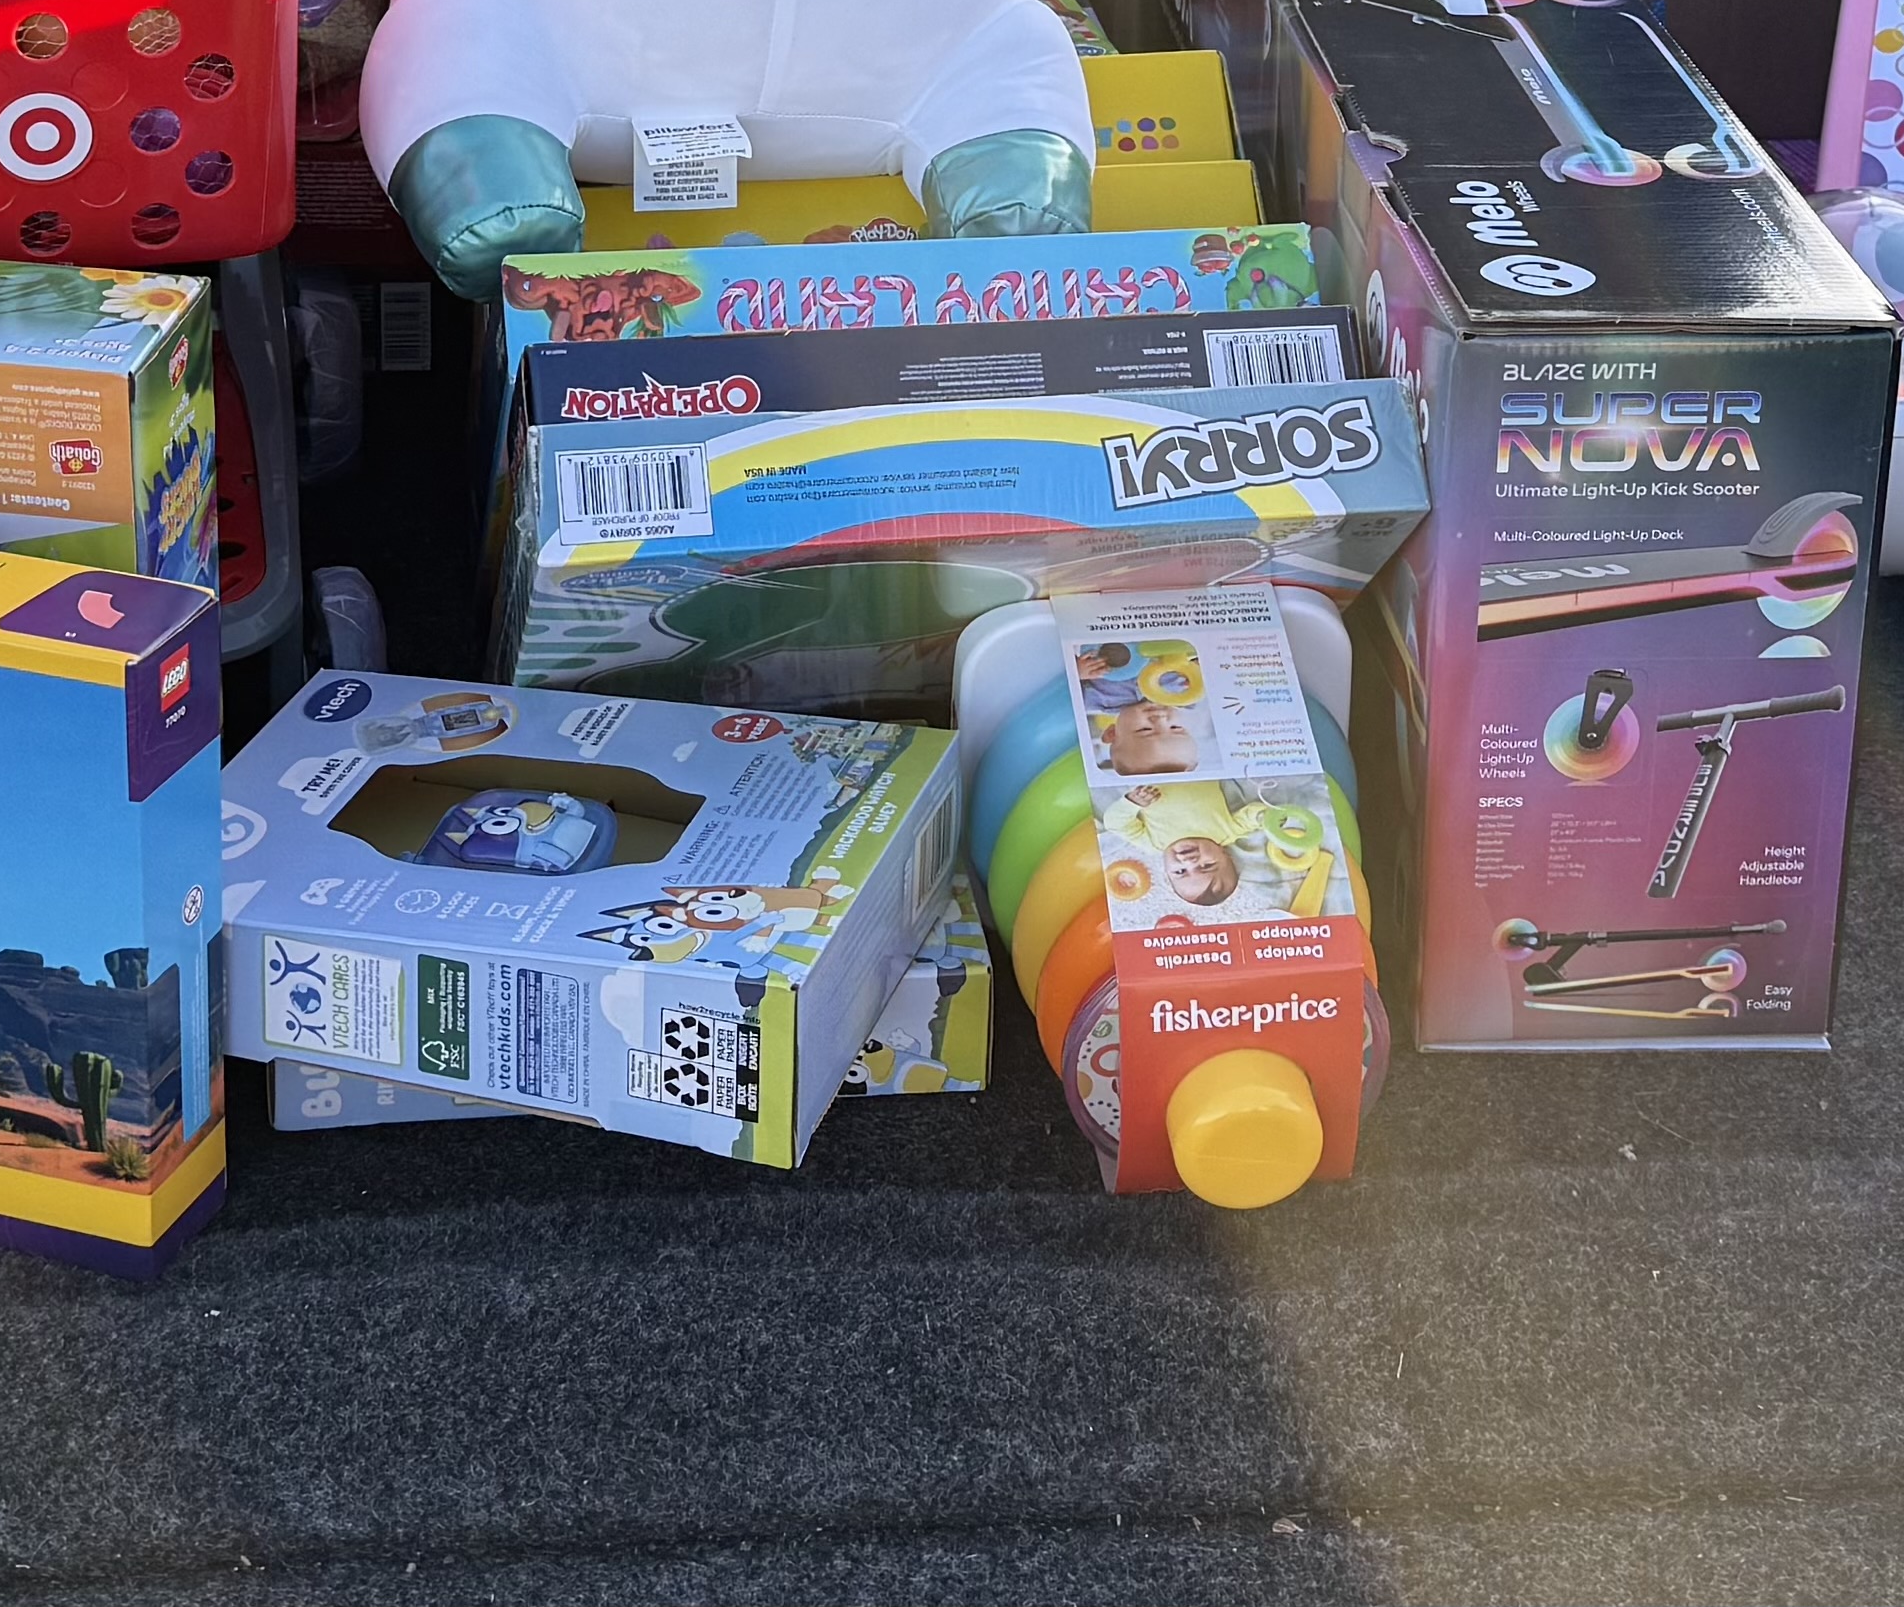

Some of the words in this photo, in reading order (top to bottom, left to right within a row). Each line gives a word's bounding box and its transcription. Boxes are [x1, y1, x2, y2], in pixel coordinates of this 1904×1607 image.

[1502, 363, 1586, 382] BLAZE
[1591, 362, 1657, 380] WITH
[559, 370, 763, 423] OPERATION
[1499, 390, 1763, 427] SUPER
[49, 442, 102, 467] Goliath
[586, 452, 628, 465] 93812
[632, 451, 673, 464] 30509
[1100, 398, 1382, 510] SORRY!
[1495, 426, 1761, 474] NOVA
[743, 466, 765, 478] USA
[778, 463, 808, 476] MADE
[1495, 483, 1569, 498] Ultimate
[1571, 482, 1648, 500] Light-Up
[1650, 482, 1688, 497] Kick
[1691, 483, 1761, 497] Scooter
[9, 492, 71, 511] Contents:
[1494, 530, 1590, 543] Multi-Coloured
[1592, 530, 1649, 543] Light-Up
[1651, 529, 1685, 541] Deck
[161, 661, 188, 700] LEGO
[314, 679, 361, 722] vtech
[164, 705, 187, 729] 77070
[723, 717, 753, 740] 3-6
[1480, 723, 1520, 736] Multi-
[1479, 738, 1539, 751] Coloured
[1478, 753, 1535, 767] Light-Up
[300, 770, 326, 794] TRY
[322, 757, 345, 781] ME!
[1478, 767, 1527, 780] Wheels
[1478, 796, 1525, 809] SPECS
[867, 801, 899, 835] BLUEY
[827, 802, 875, 860] WACKADOO
[1764, 844, 1807, 859] Height
[1738, 859, 1805, 874] Adjustable
[1738, 874, 1804, 887] Handlebar
[1142, 930, 1230, 950] Desenvolve
[1251, 923, 1331, 943] Développe
[1154, 951, 1232, 969] Desarrolla
[1254, 943, 1325, 962] Develops
[332, 953, 350, 1003] CARES
[1764, 984, 1794, 997] Easy
[1148, 994, 1342, 1035] fisher-price
[1745, 998, 1792, 1012] Folding
[332, 1005, 350, 1050] VTECH
[499, 963, 513, 1091] vtechkids.com
